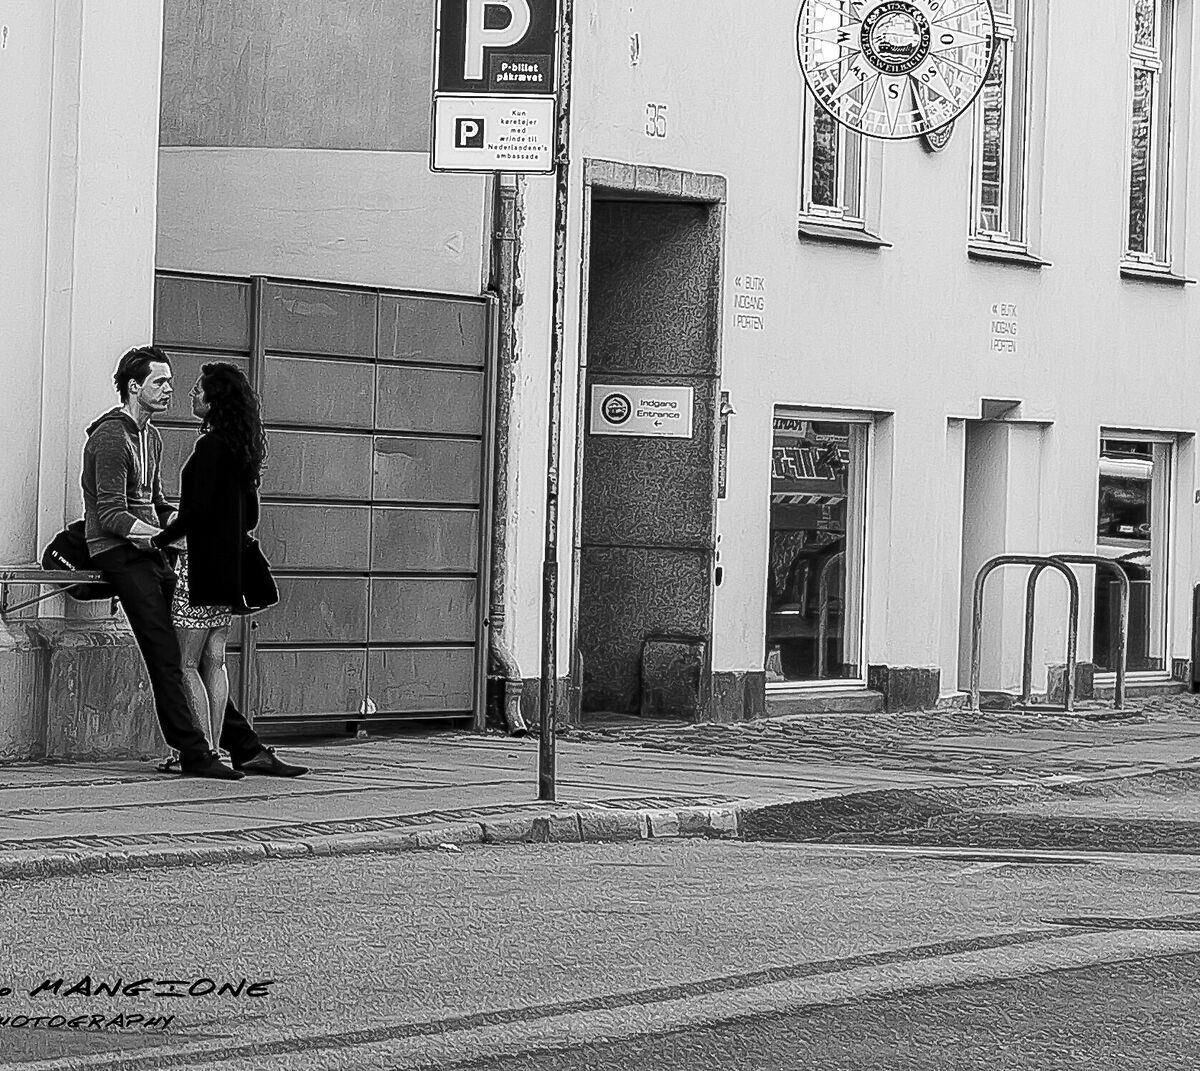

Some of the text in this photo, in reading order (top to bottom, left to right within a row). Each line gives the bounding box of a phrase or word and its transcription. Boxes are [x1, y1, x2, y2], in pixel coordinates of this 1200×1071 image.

[501, 62, 539, 72] P-billet
[496, 71, 543, 82] påkrævet
[500, 117, 538, 126] køretøjer
[646, 103, 667, 137] 35
[460, 120, 480, 146] P
[527, 135, 538, 143] til
[640, 399, 678, 409] Indgang
[636, 410, 680, 419] Entrance
